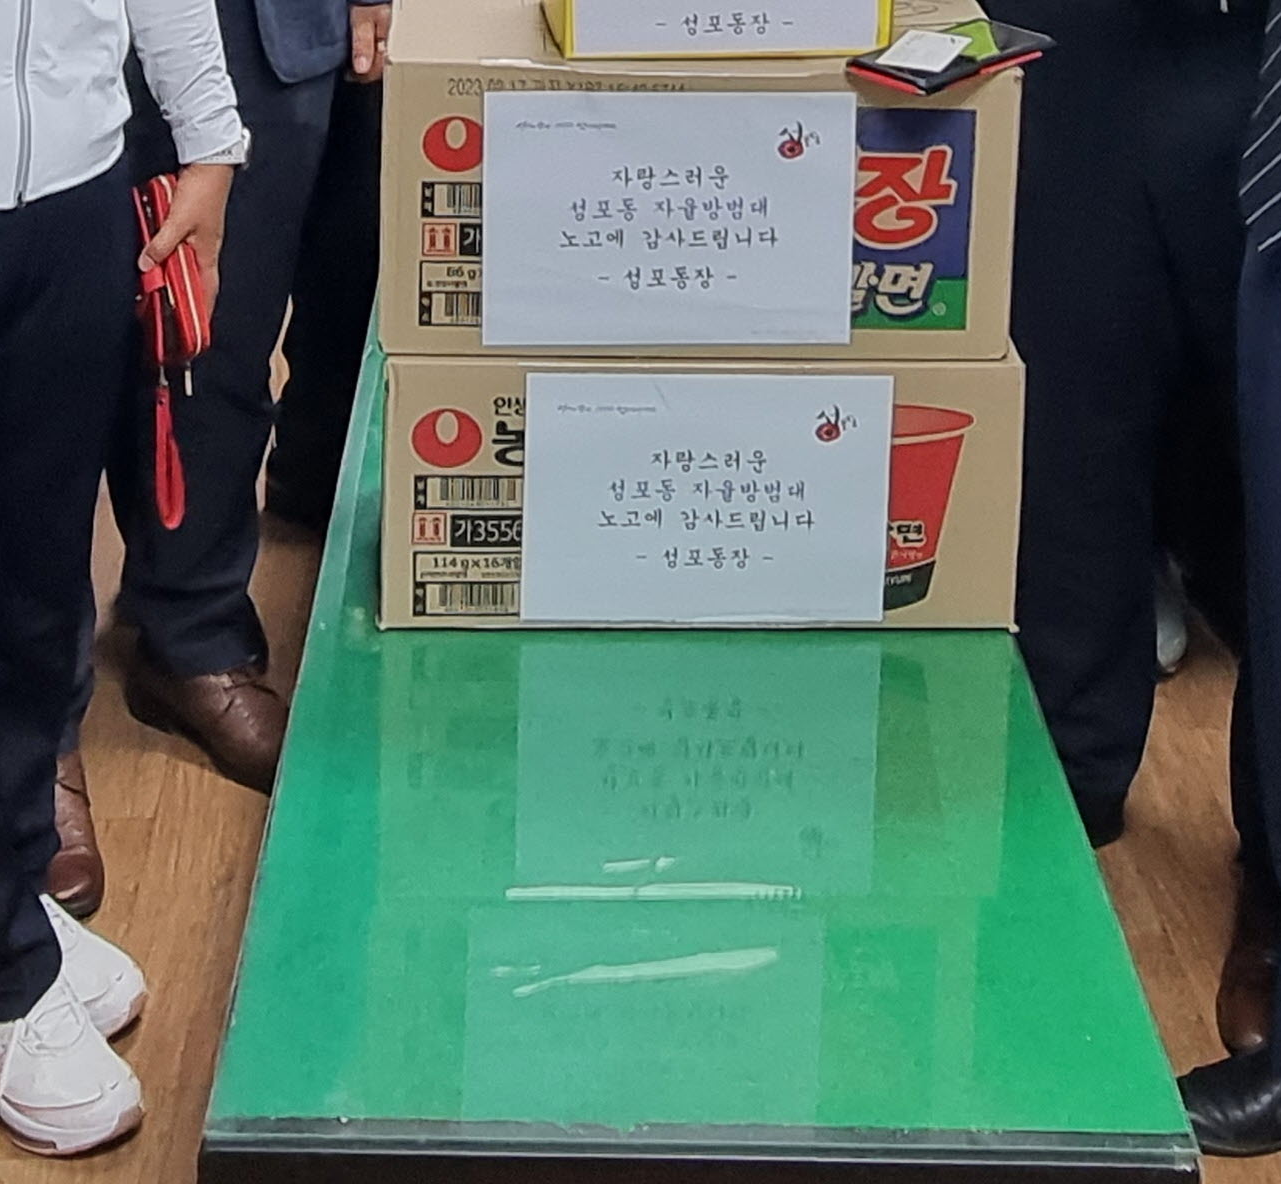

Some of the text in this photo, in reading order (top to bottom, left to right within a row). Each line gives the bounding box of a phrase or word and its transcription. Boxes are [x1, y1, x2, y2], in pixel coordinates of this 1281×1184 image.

[682, 12, 771, 37] 성포동장
[612, 165, 730, 191] 자랑스러운
[570, 196, 769, 222] 성포동 자율방범대
[559, 226, 779, 250] 노고에 감사드립니다
[624, 265, 715, 291] 성포동장
[651, 449, 767, 473] 자랑스러운
[609, 478, 806, 504] 성포동 자율방범대
[598, 508, 815, 532] 노고에 감사드립니다
[887, 522, 925, 544] 면
[663, 546, 750, 570] 성포동장
